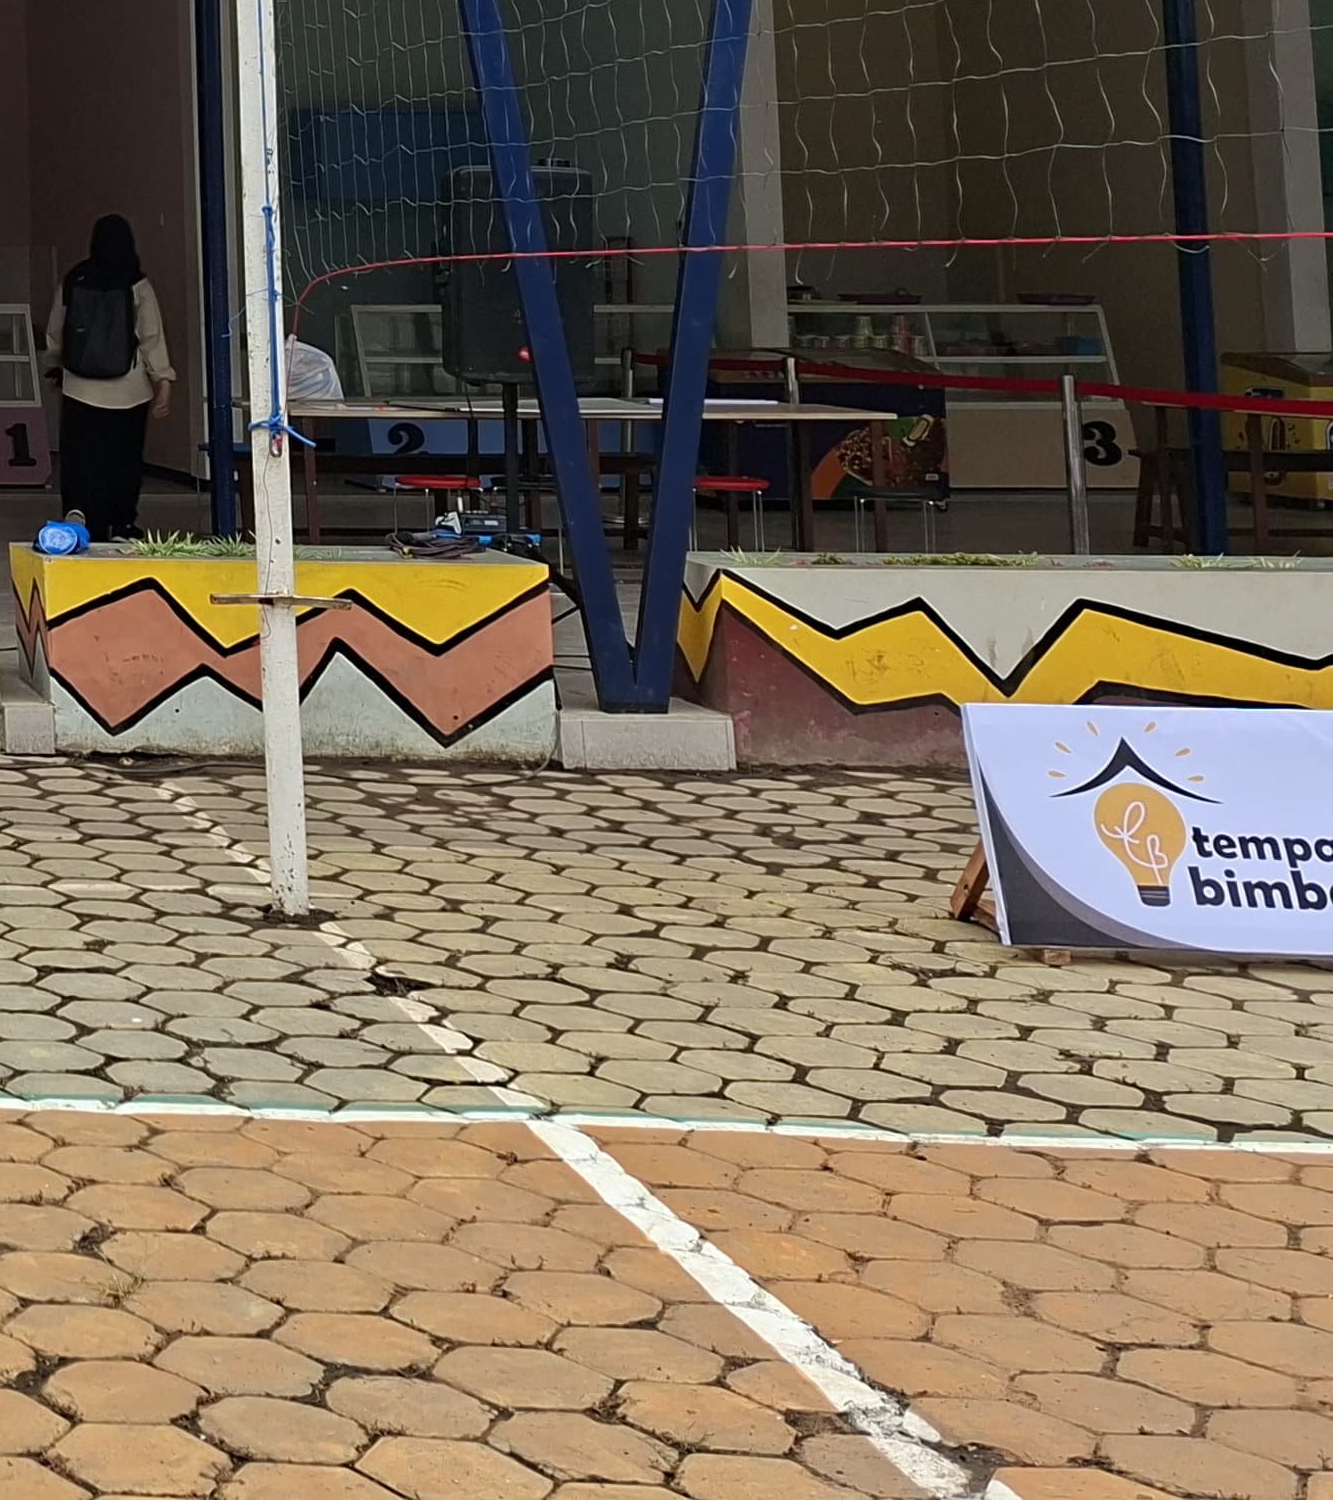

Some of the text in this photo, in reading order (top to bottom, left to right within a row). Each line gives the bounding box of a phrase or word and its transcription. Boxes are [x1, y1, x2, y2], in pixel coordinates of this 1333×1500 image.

[5, 422, 37, 467] 1
[1083, 420, 1122, 466] 3
[1188, 866, 1333, 911] bimb
